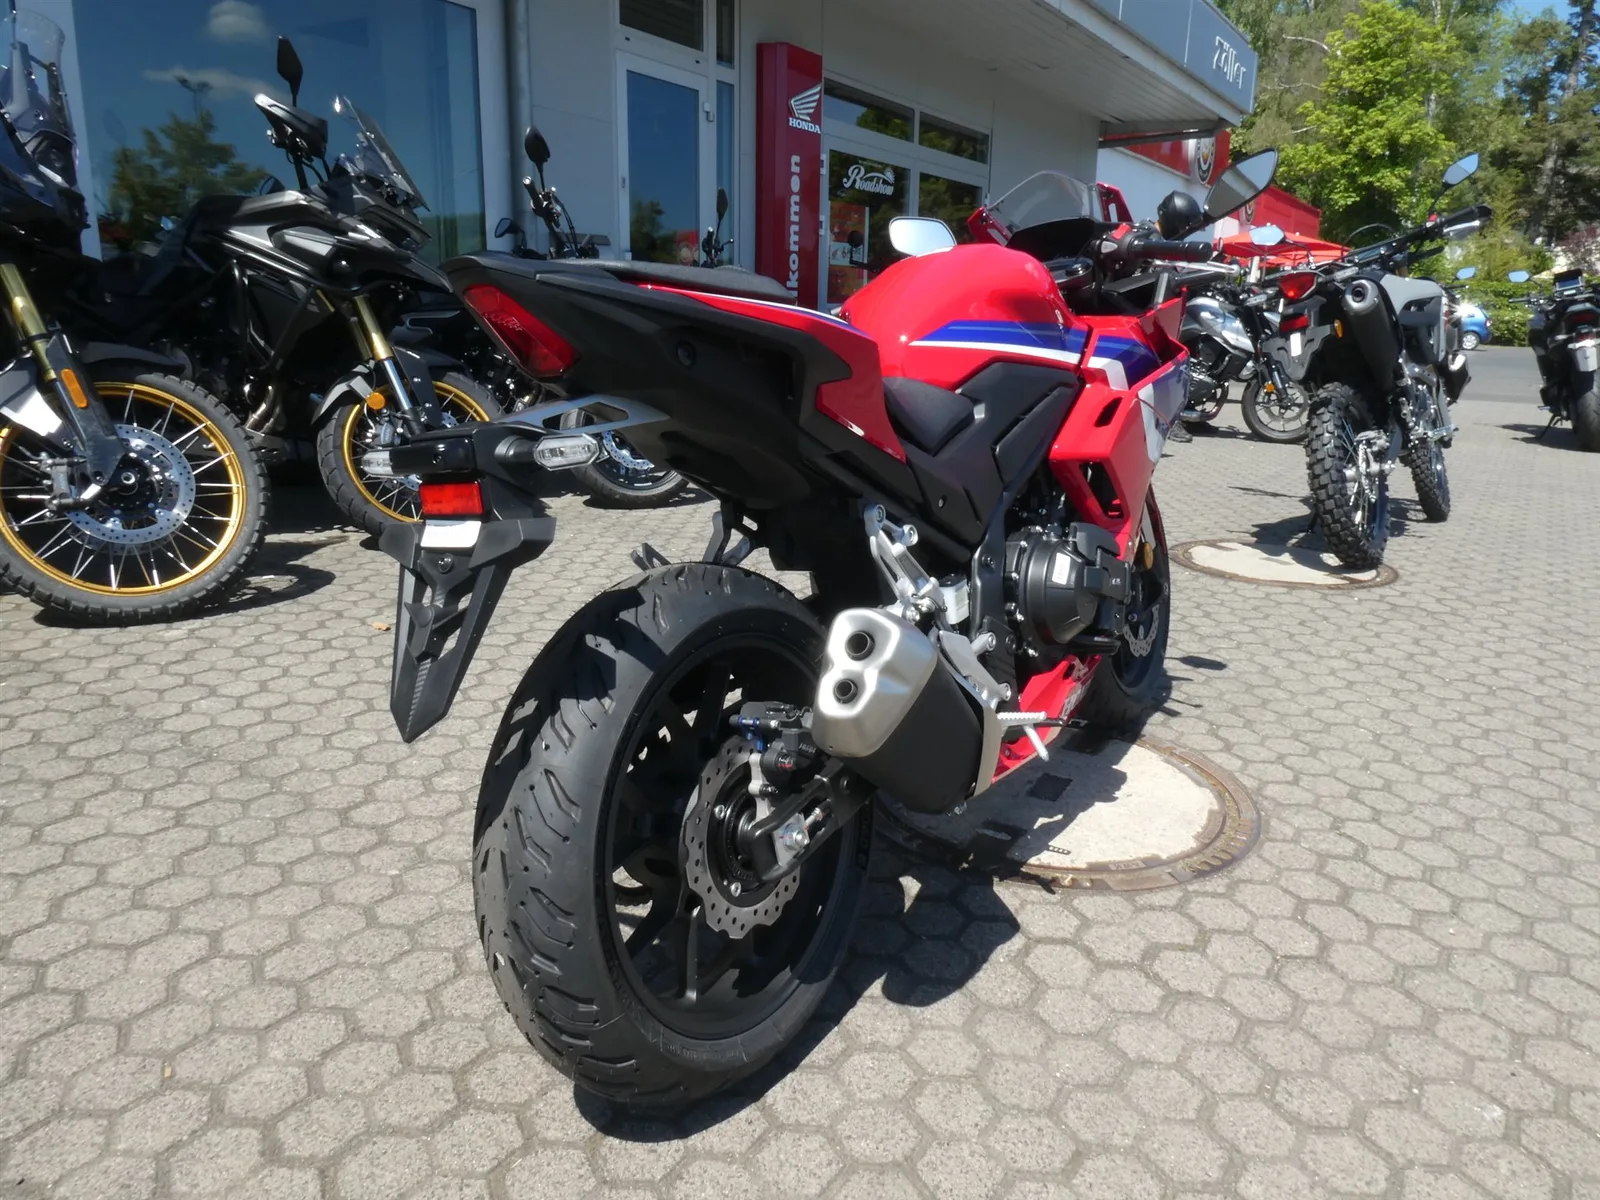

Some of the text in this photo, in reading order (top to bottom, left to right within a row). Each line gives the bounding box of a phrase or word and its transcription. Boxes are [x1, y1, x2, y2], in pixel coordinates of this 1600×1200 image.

[788, 116, 821, 134] HONDA
[842, 164, 895, 196] Roadshow
[786, 154, 801, 306] kommen
